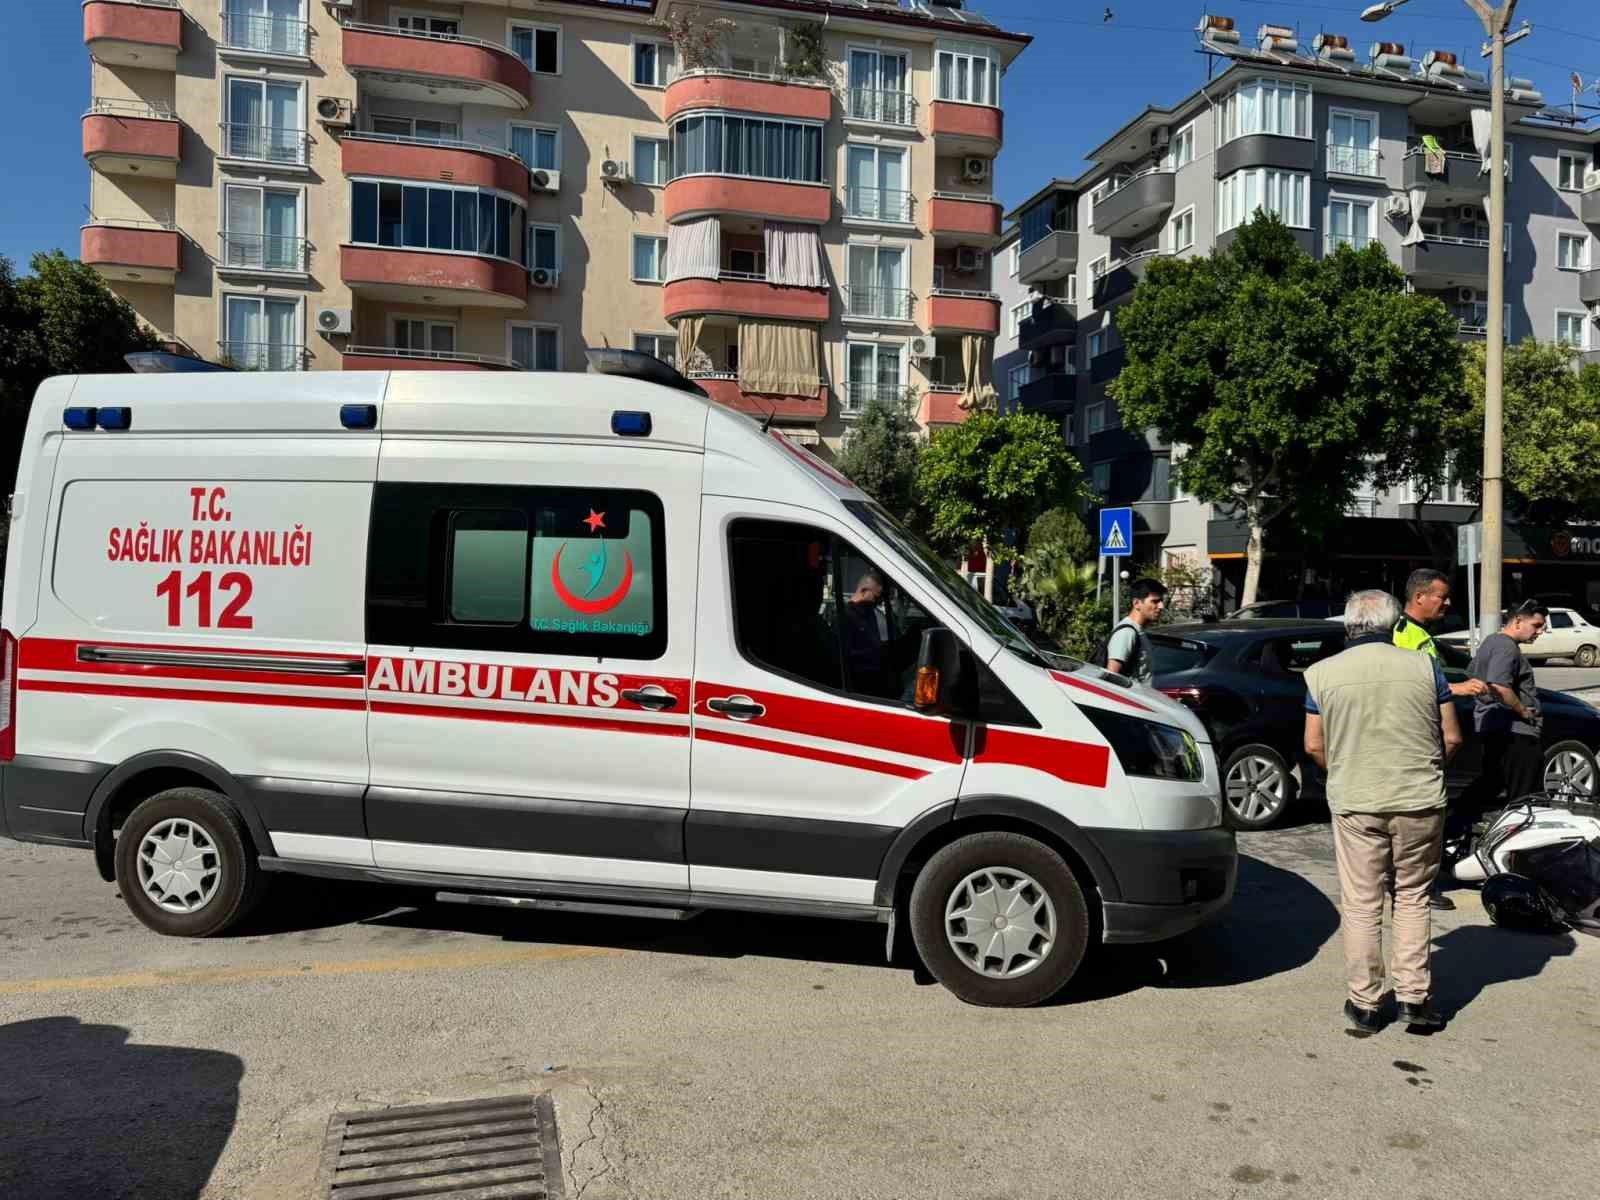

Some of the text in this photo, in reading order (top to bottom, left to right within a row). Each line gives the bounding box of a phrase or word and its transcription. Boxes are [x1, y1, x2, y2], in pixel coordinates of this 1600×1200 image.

[190, 486, 232, 521] T.C.
[107, 521, 313, 567] SAĞLIK BAKANLIĞI
[156, 570, 254, 629] 112
[368, 657, 620, 708] AMBULANS
